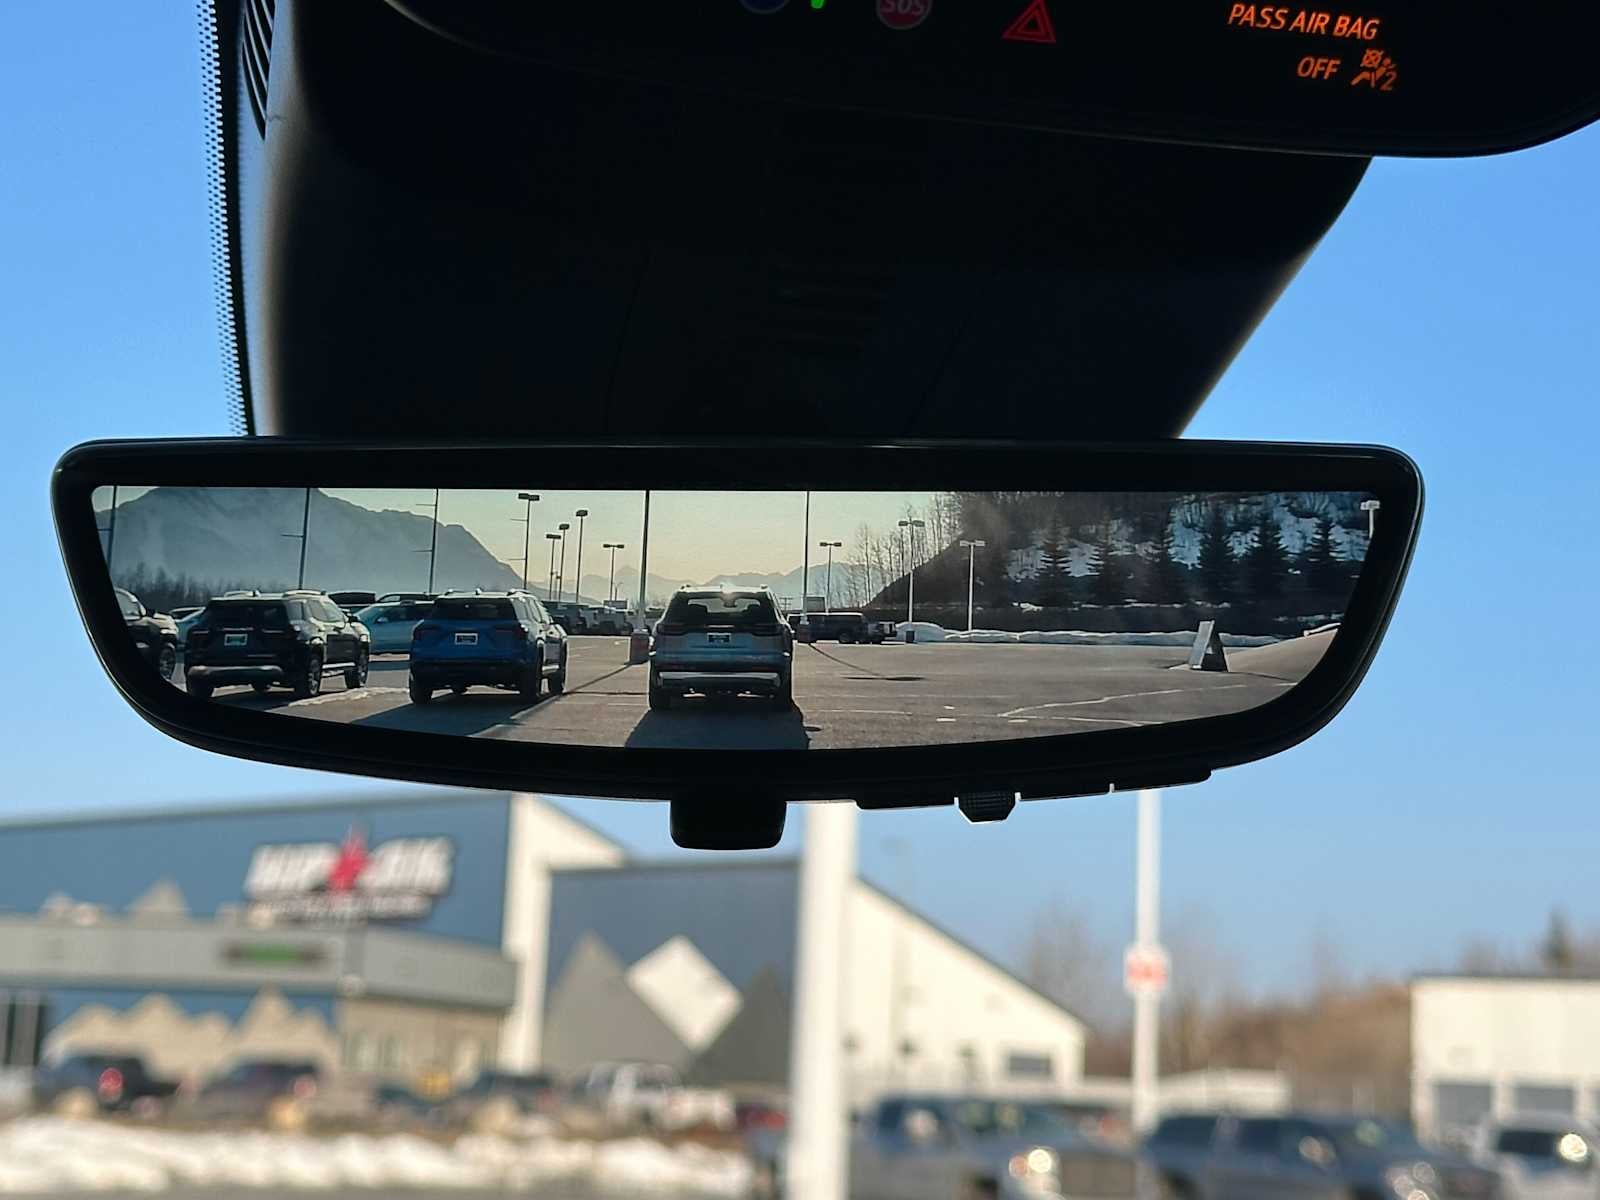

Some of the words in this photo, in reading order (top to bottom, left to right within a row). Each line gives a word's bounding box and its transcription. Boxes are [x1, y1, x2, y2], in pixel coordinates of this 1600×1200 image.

[1228, 3, 1288, 30] PASS
[1288, 10, 1330, 35] AIR
[1332, 15, 1380, 41] BAG
[1297, 56, 1341, 80] OFF
